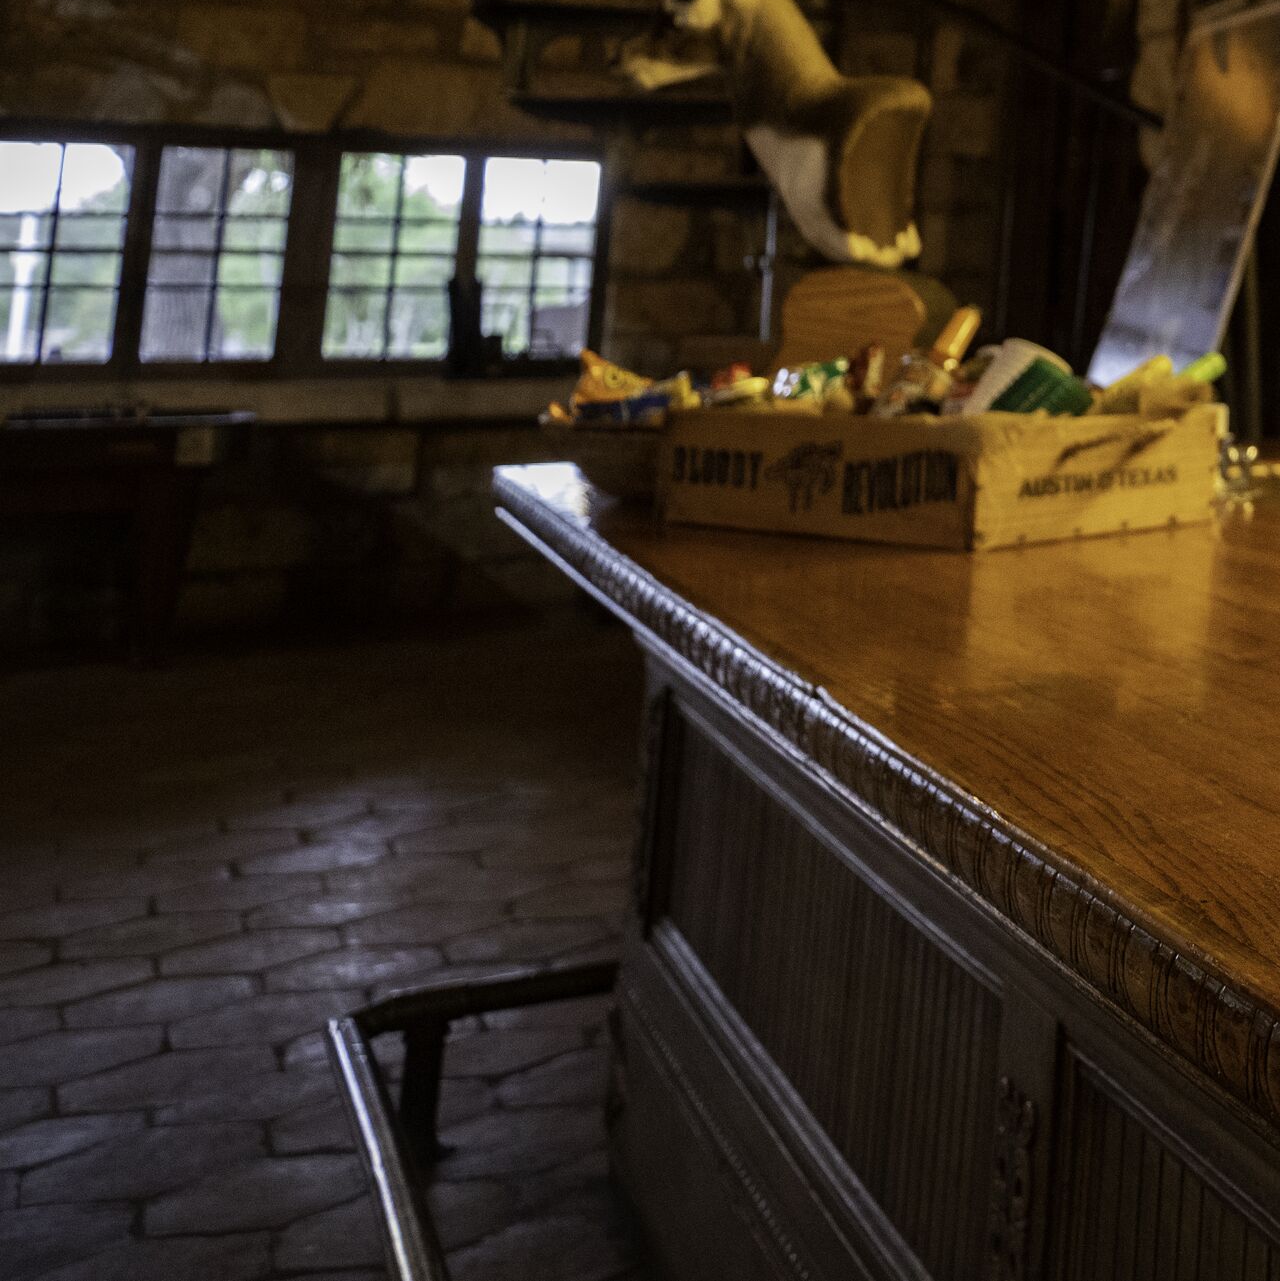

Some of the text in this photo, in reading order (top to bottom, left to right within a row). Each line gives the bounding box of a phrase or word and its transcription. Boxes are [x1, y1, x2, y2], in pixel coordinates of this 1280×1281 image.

[842, 447, 961, 517] REVOLUTION
[1018, 466, 1178, 500] AUSTIN TEXAS
